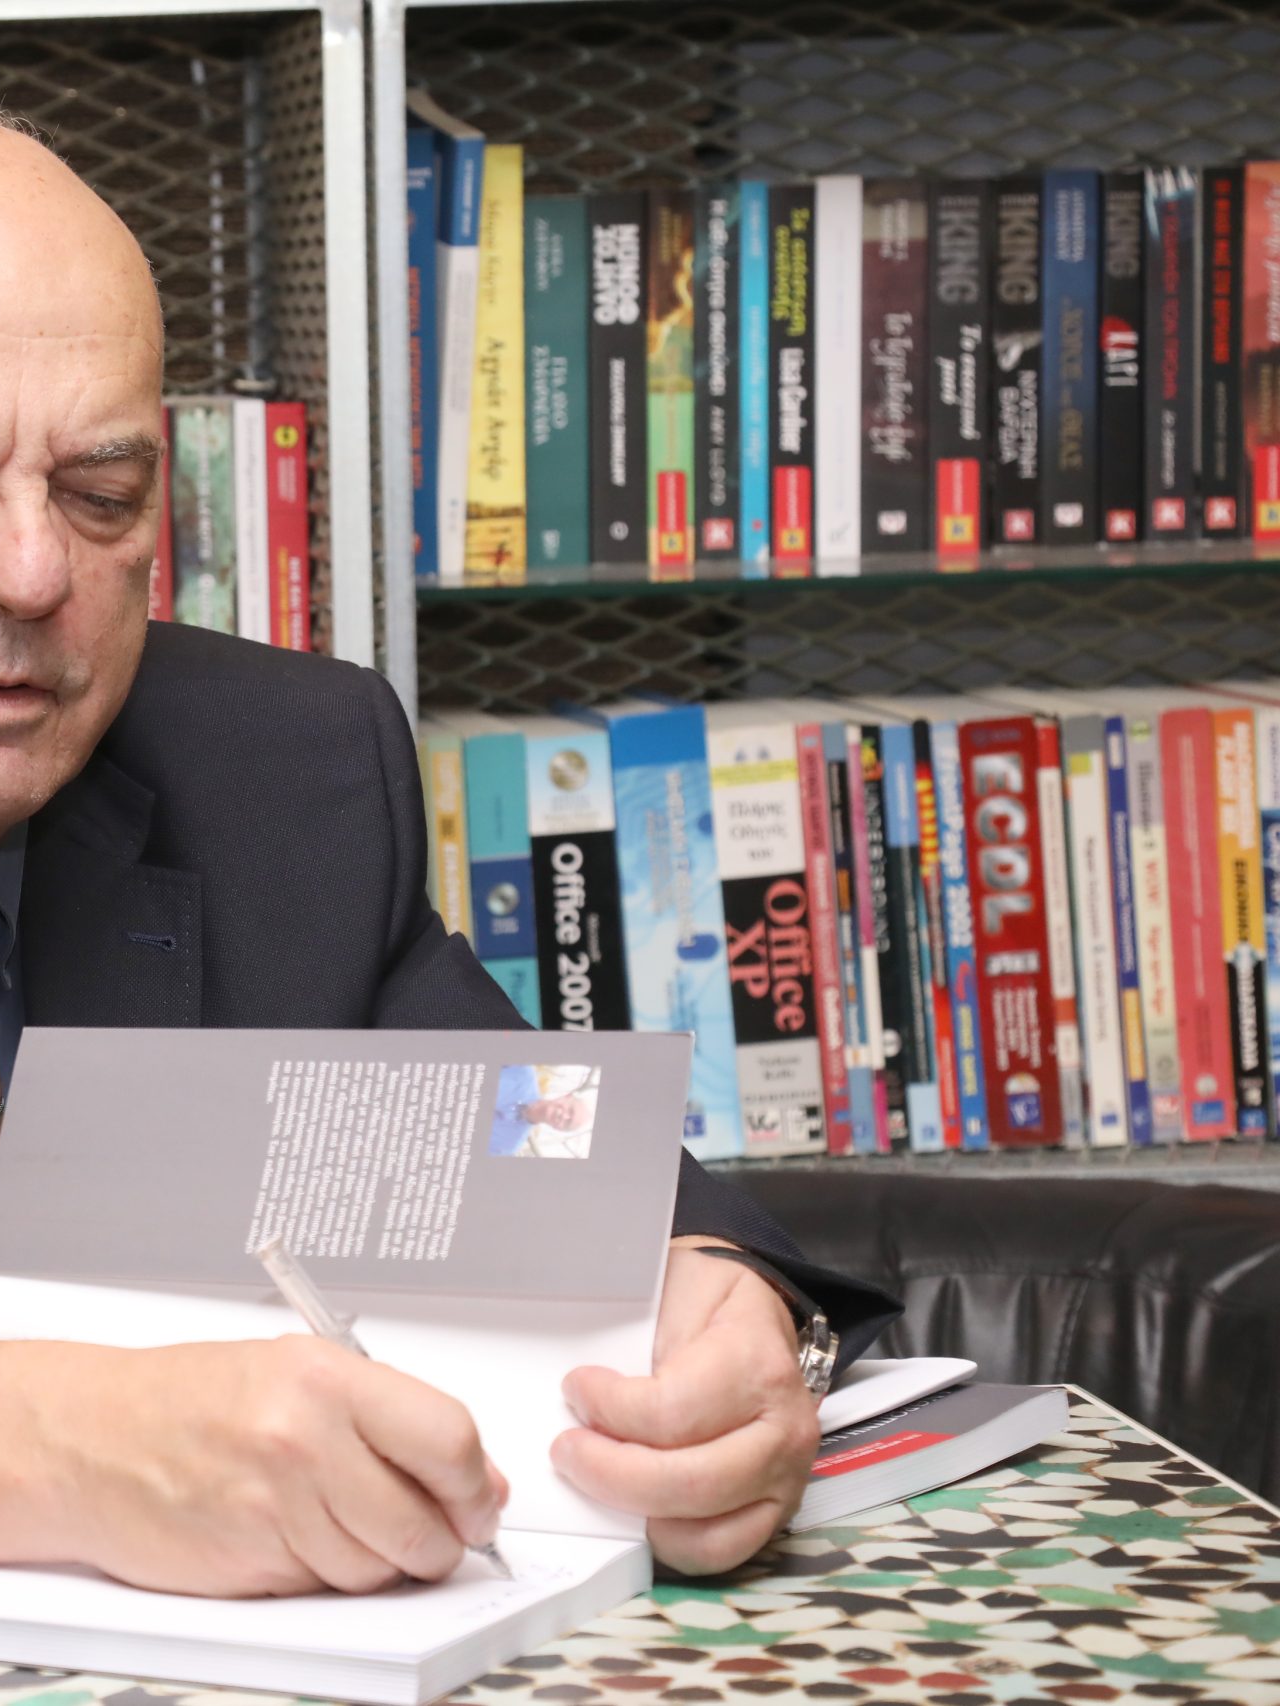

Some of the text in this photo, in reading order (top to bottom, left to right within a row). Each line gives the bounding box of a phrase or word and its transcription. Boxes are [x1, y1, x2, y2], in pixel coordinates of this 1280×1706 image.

[936, 211, 978, 304] KING
[997, 208, 1037, 304] KING
[1103, 203, 1139, 278] KING
[777, 347, 806, 455] Lisa Gardner
[970, 752, 1034, 937] ECDL
[551, 842, 594, 1031] Office 2007
[725, 919, 771, 999] XP
[765, 879, 811, 1032] Office
